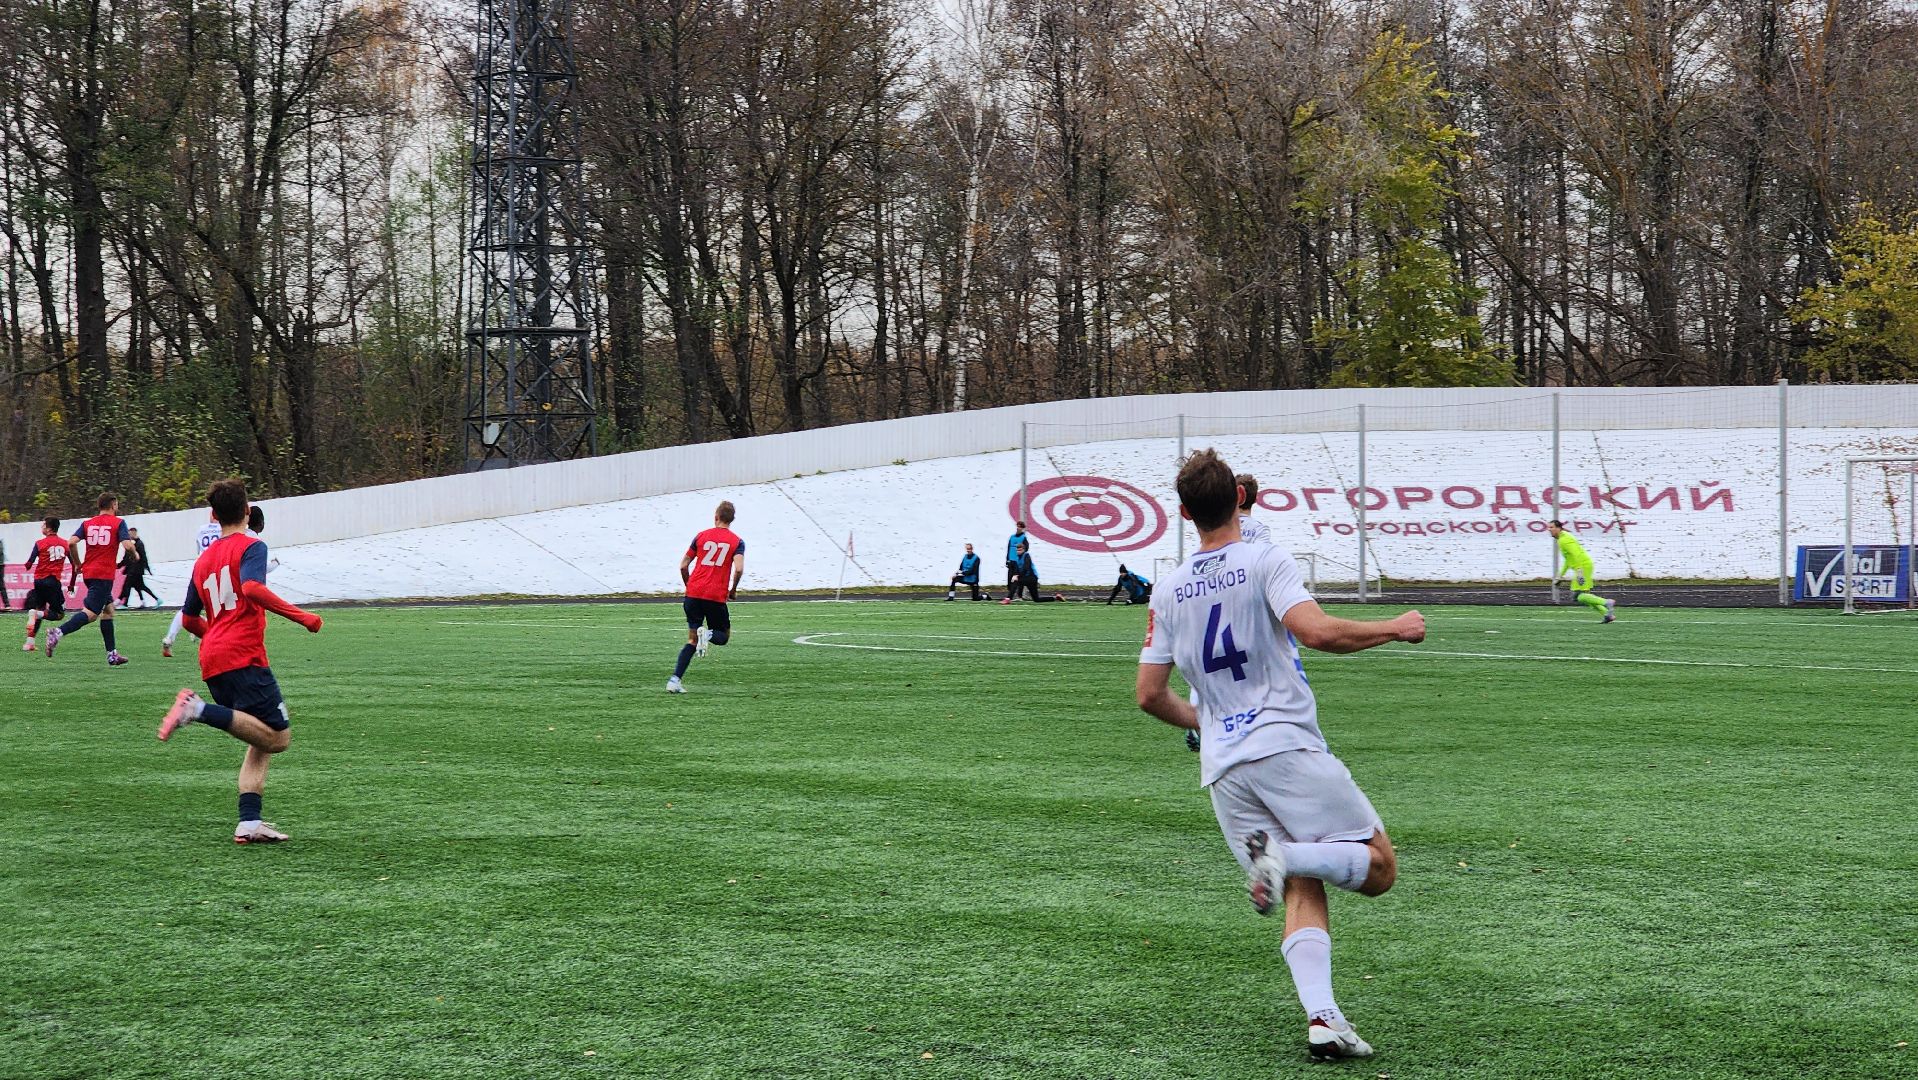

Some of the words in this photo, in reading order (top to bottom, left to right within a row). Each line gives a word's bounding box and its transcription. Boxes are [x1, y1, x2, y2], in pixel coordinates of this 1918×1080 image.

[1256, 480, 1736, 515] ОГОРОДСКИЙ
[87, 525, 111, 546] 55
[700, 540, 731, 567] 27
[202, 564, 238, 618] 14
[1175, 568, 1247, 604] ВОЛЧКОВ
[1804, 550, 1882, 598] Vtal
[1202, 602, 1249, 682] 4
